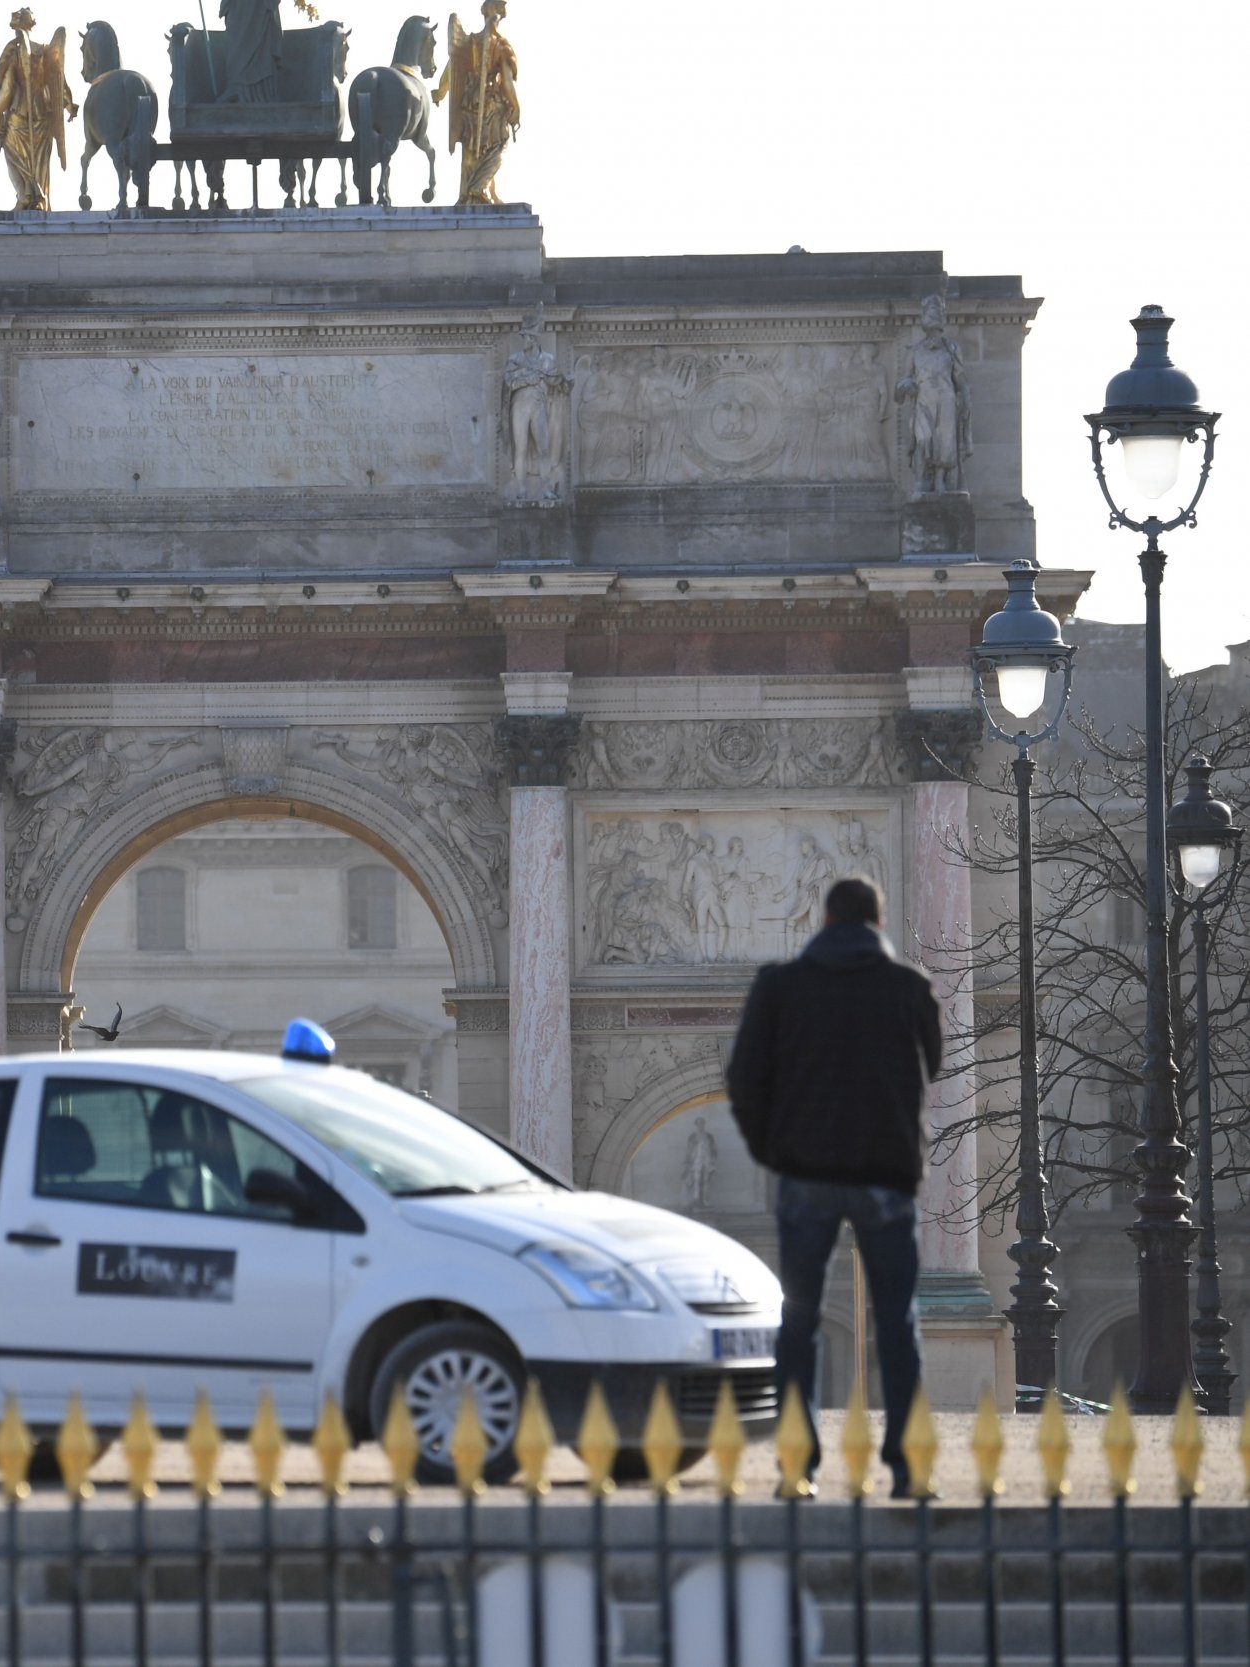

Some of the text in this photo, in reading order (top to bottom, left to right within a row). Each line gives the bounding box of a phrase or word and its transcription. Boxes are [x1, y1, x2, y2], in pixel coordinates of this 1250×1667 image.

[141, 376, 157, 390] LA
[161, 376, 190, 389] VOIX
[196, 375, 212, 388] DU
[218, 375, 284, 388] VAINQUEUR
[68, 426, 94, 439] LES
